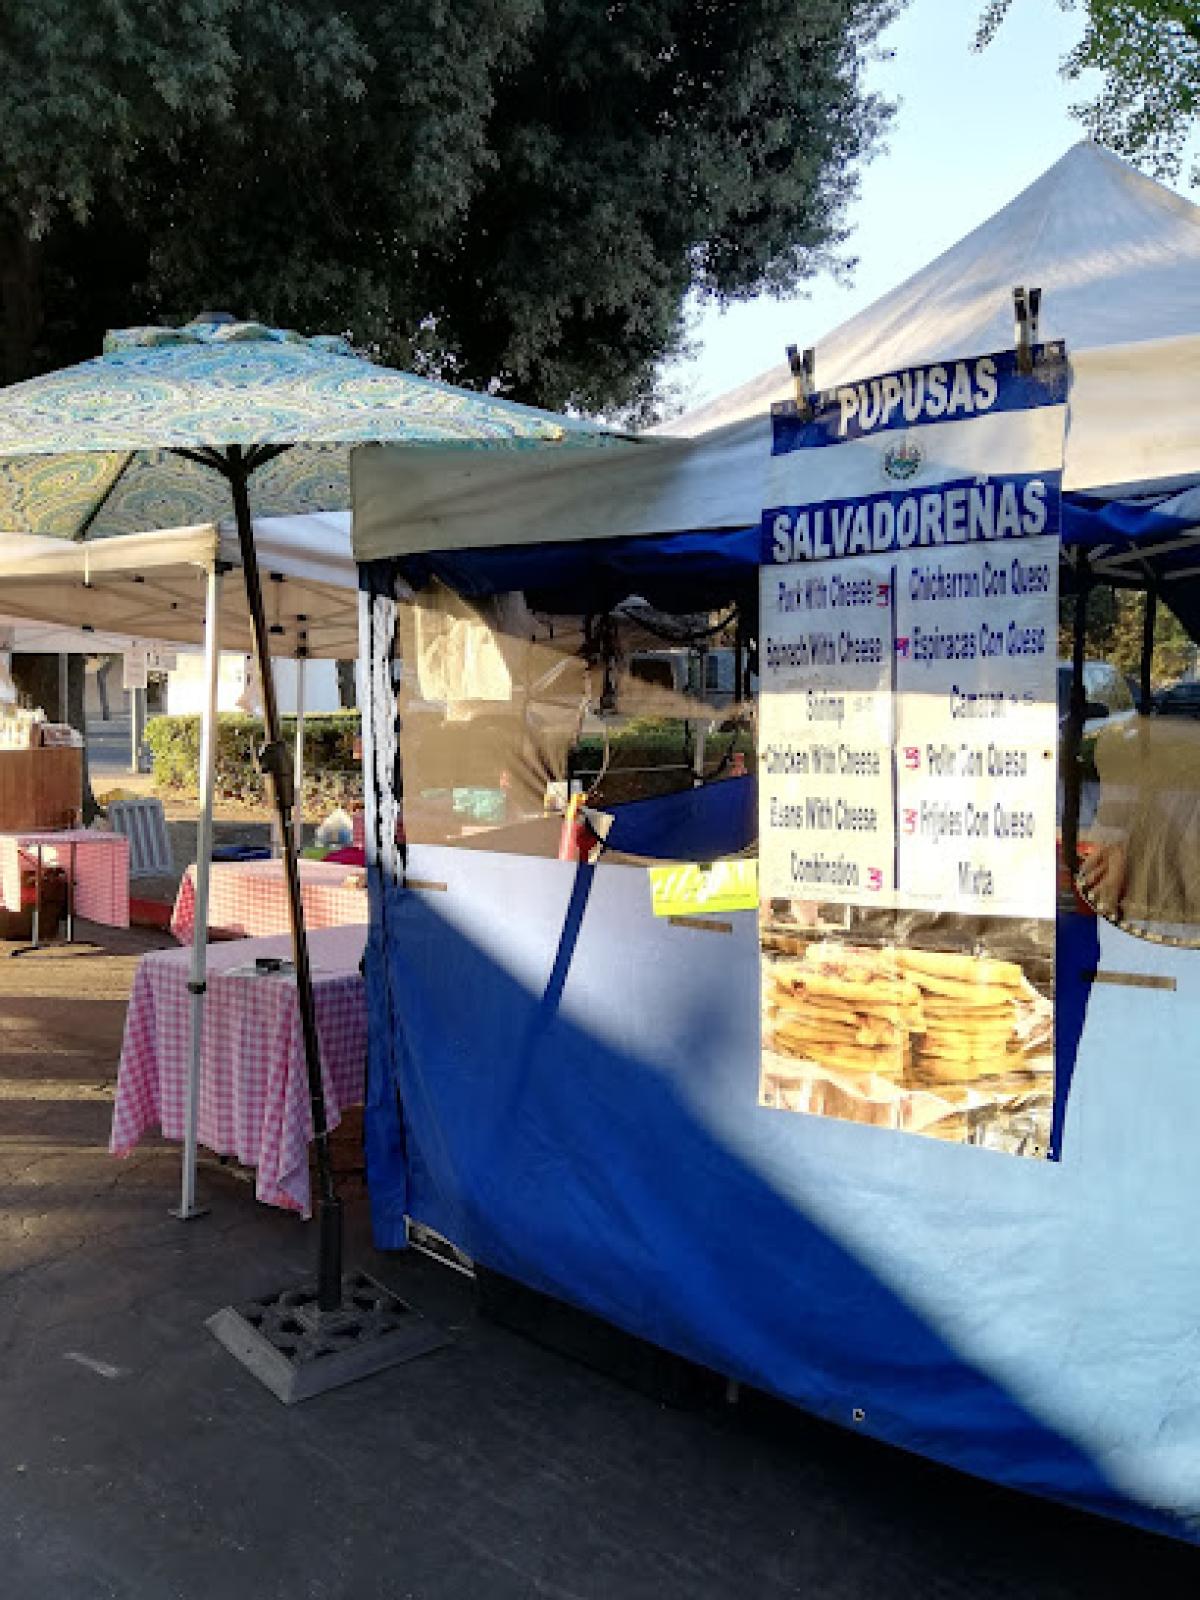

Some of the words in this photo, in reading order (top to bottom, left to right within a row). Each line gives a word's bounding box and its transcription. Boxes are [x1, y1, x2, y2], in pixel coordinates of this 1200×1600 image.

[838, 357, 998, 436] PUPUSAS
[831, 573, 873, 606] Cheese
[982, 560, 1006, 598] Con
[1011, 558, 1049, 596] Queso
[838, 630, 883, 664] Cheese
[914, 625, 976, 668] Espinacas
[980, 623, 1003, 657] Con
[1008, 620, 1045, 656] Queso
[767, 743, 808, 775] Chicken
[838, 743, 880, 777] Cheese
[987, 741, 1027, 778] Queso
[835, 799, 877, 832] Cheese
[964, 802, 989, 837] Con
[993, 802, 1035, 838] Queso
